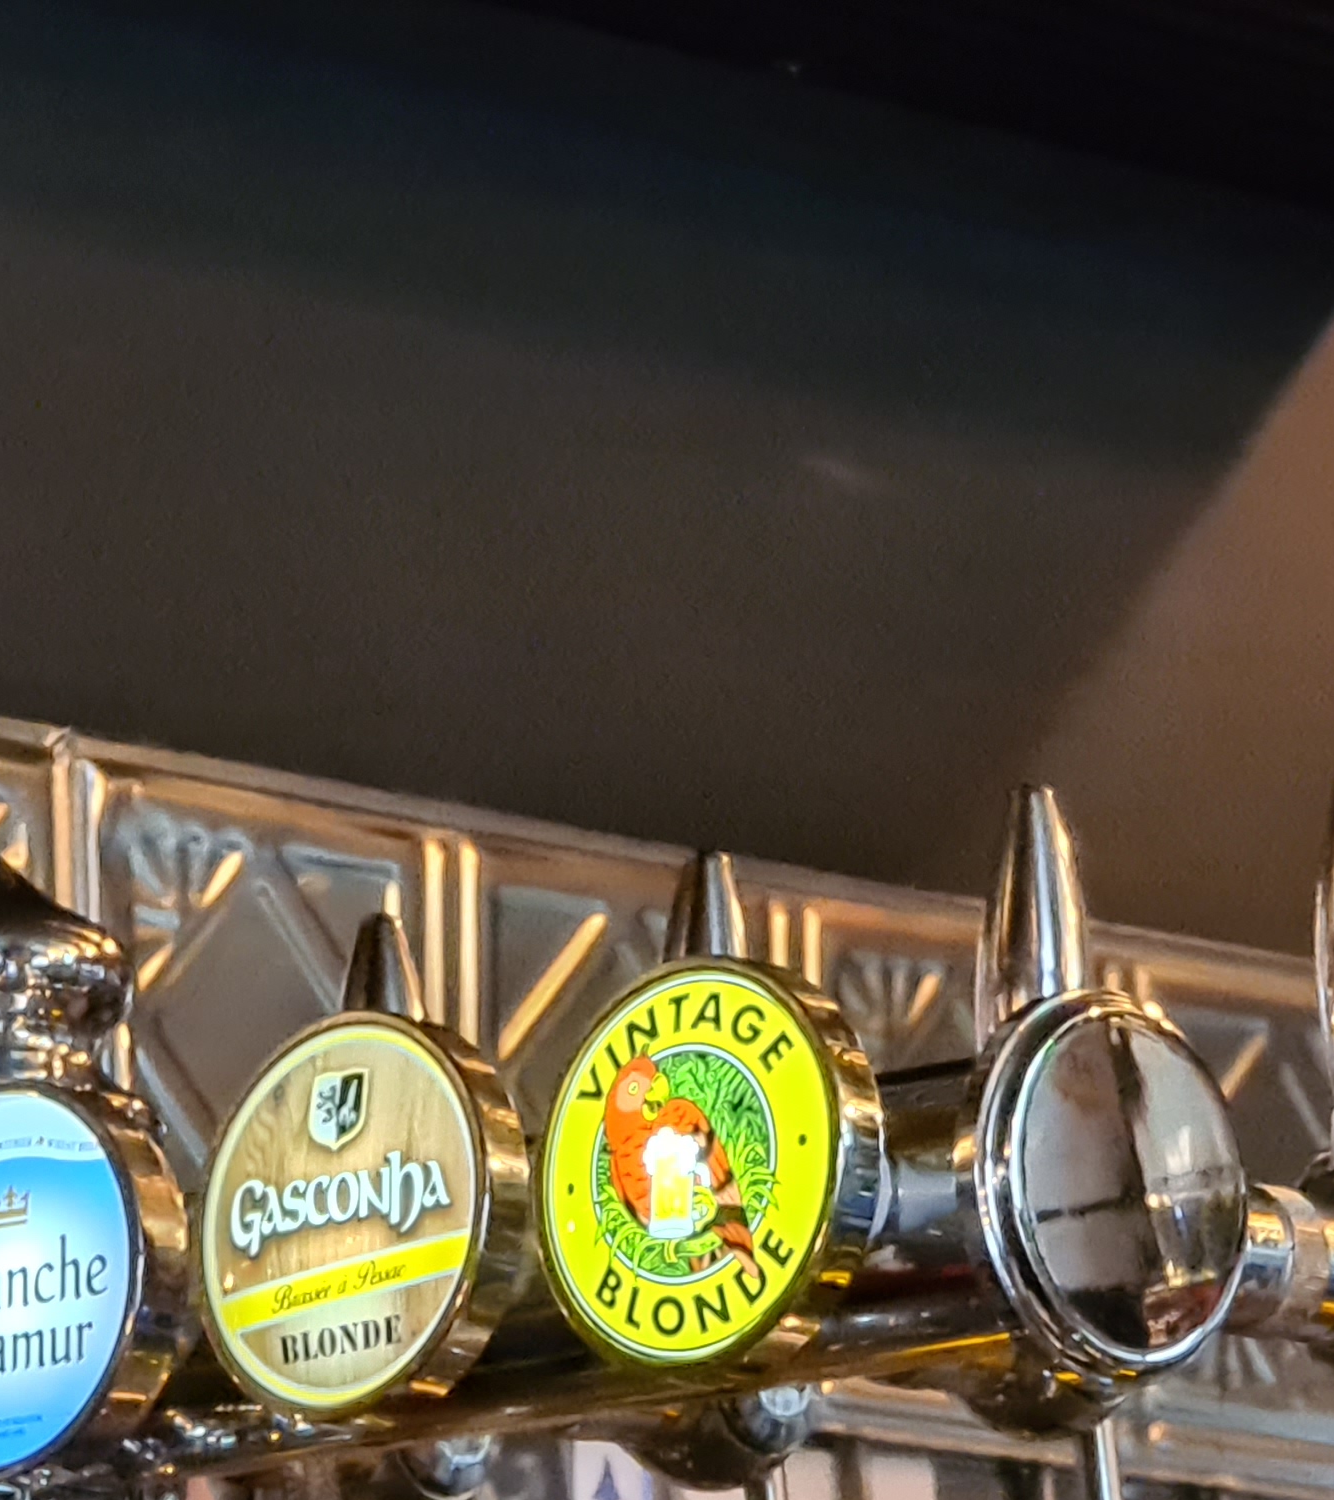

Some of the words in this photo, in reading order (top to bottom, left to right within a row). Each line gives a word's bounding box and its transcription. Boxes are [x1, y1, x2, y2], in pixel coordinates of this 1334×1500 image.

[576, 991, 795, 1103] VINTAGE
[595, 1228, 795, 1335] BLONDE
[280, 1314, 402, 1365] BLONDE
